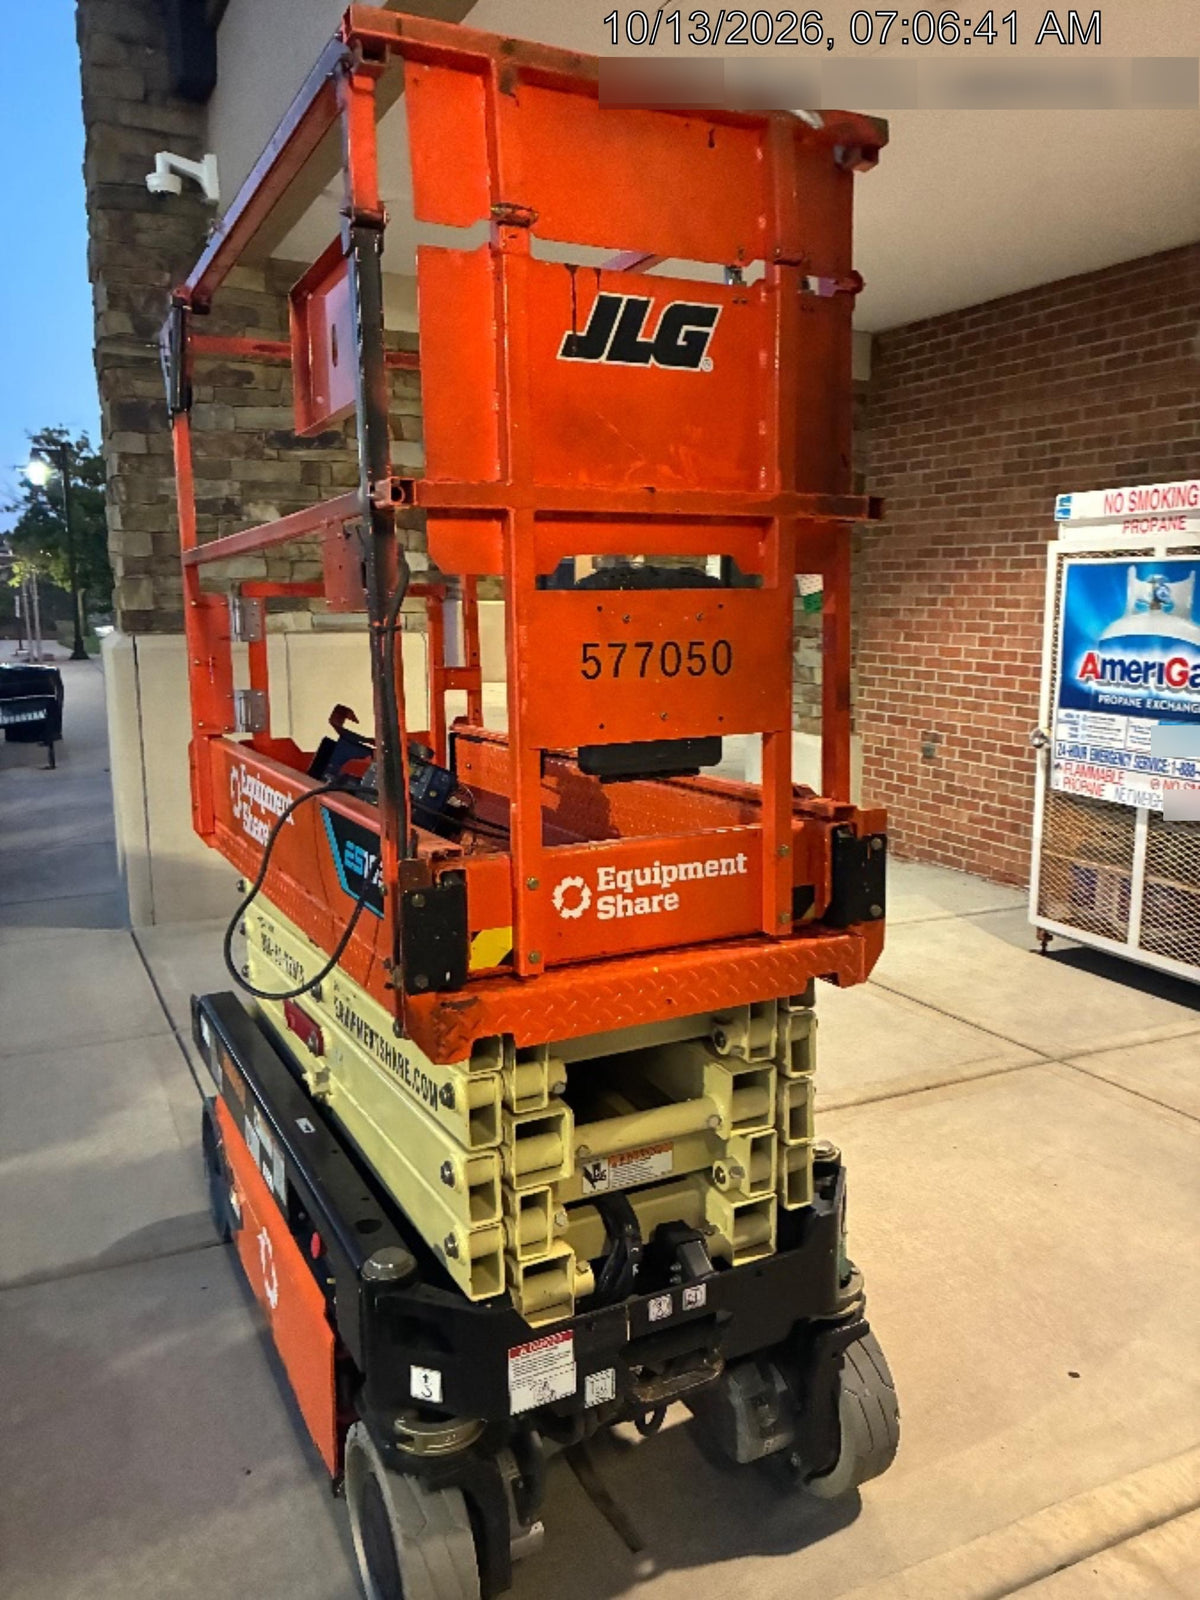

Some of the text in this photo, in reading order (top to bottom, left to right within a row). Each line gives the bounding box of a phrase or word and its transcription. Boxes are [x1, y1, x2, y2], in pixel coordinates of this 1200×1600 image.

[556, 290, 723, 372] JLG
[1103, 484, 1199, 514] NO SMOKING
[1121, 515, 1187, 534] PROPANE
[581, 639, 733, 680] 577050
[1097, 693, 1143, 708] PROPANE
[1063, 762, 1125, 786] FLAMMABLE
[1063, 776, 1106, 797] PROPANE
[596, 852, 748, 894] Equipment
[596, 891, 680, 920] Share
